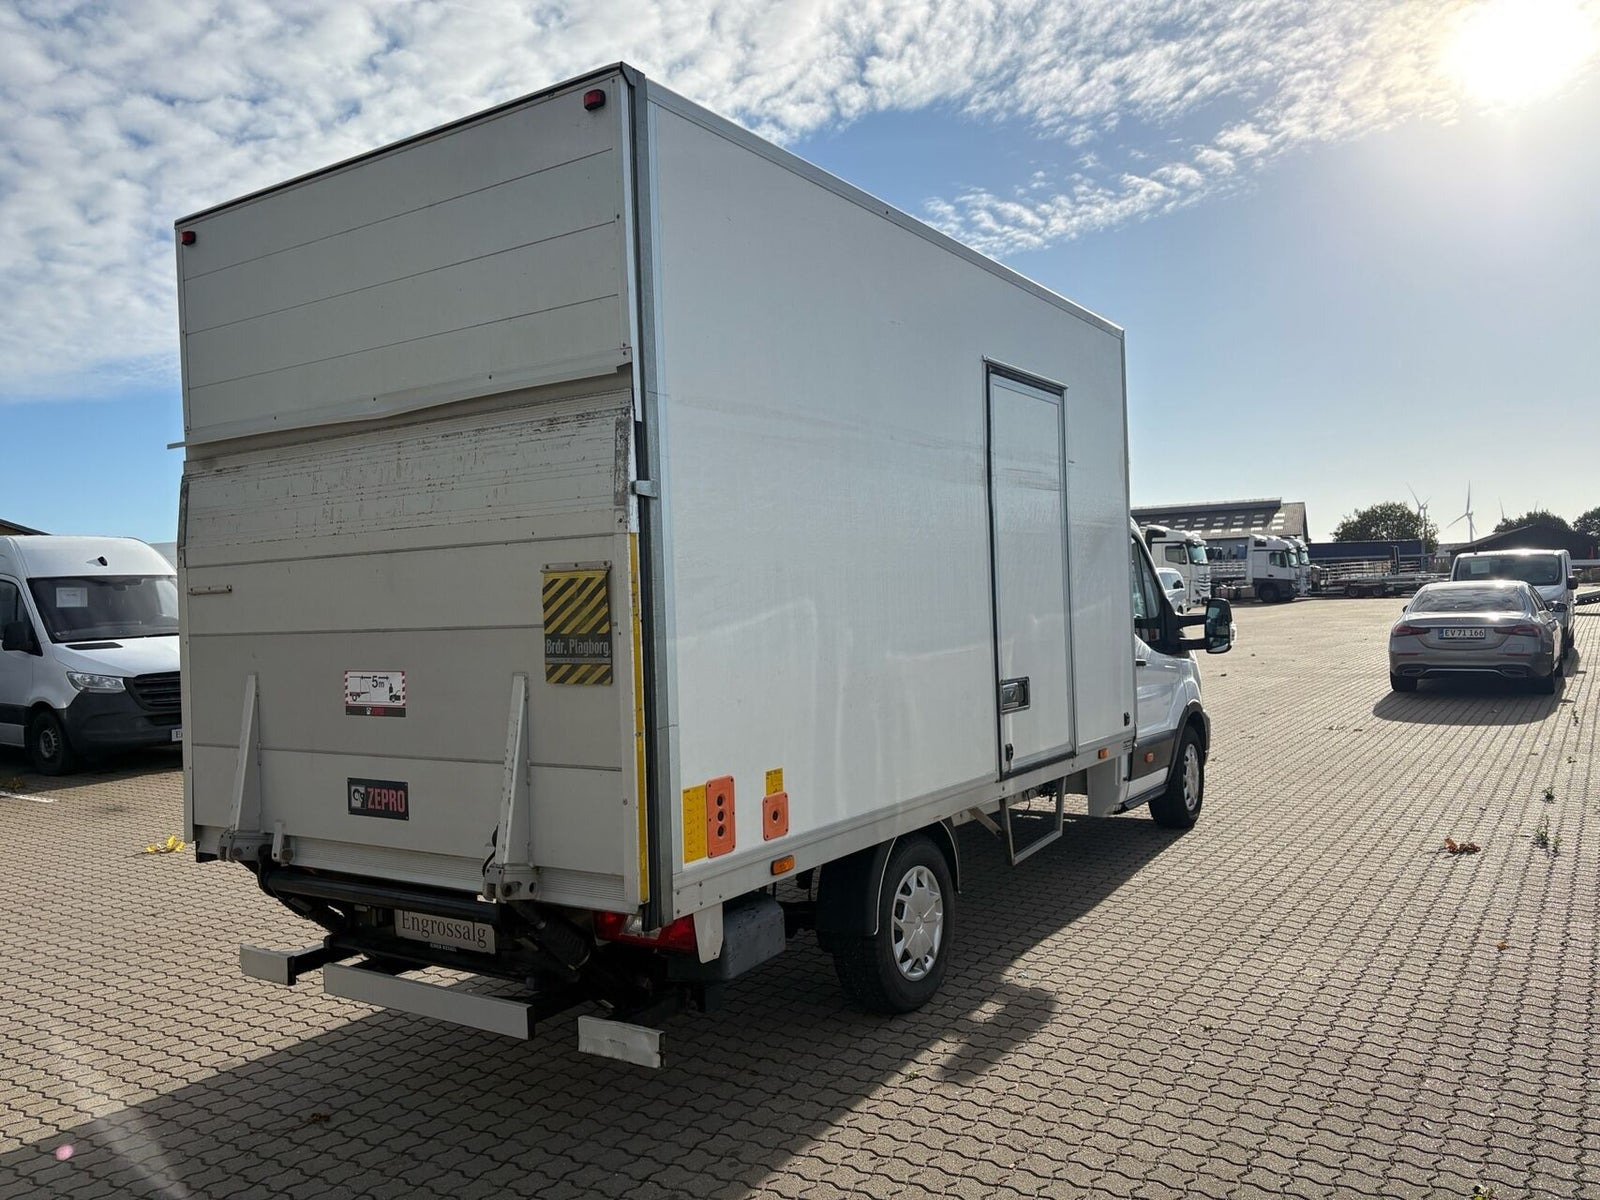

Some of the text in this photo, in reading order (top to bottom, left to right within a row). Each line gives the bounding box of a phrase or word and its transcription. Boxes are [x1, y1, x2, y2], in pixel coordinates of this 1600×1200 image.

[546, 638, 567, 655] Brdr.
[367, 787, 406, 813] ZEPRO
[401, 910, 486, 948] Engrossalg
